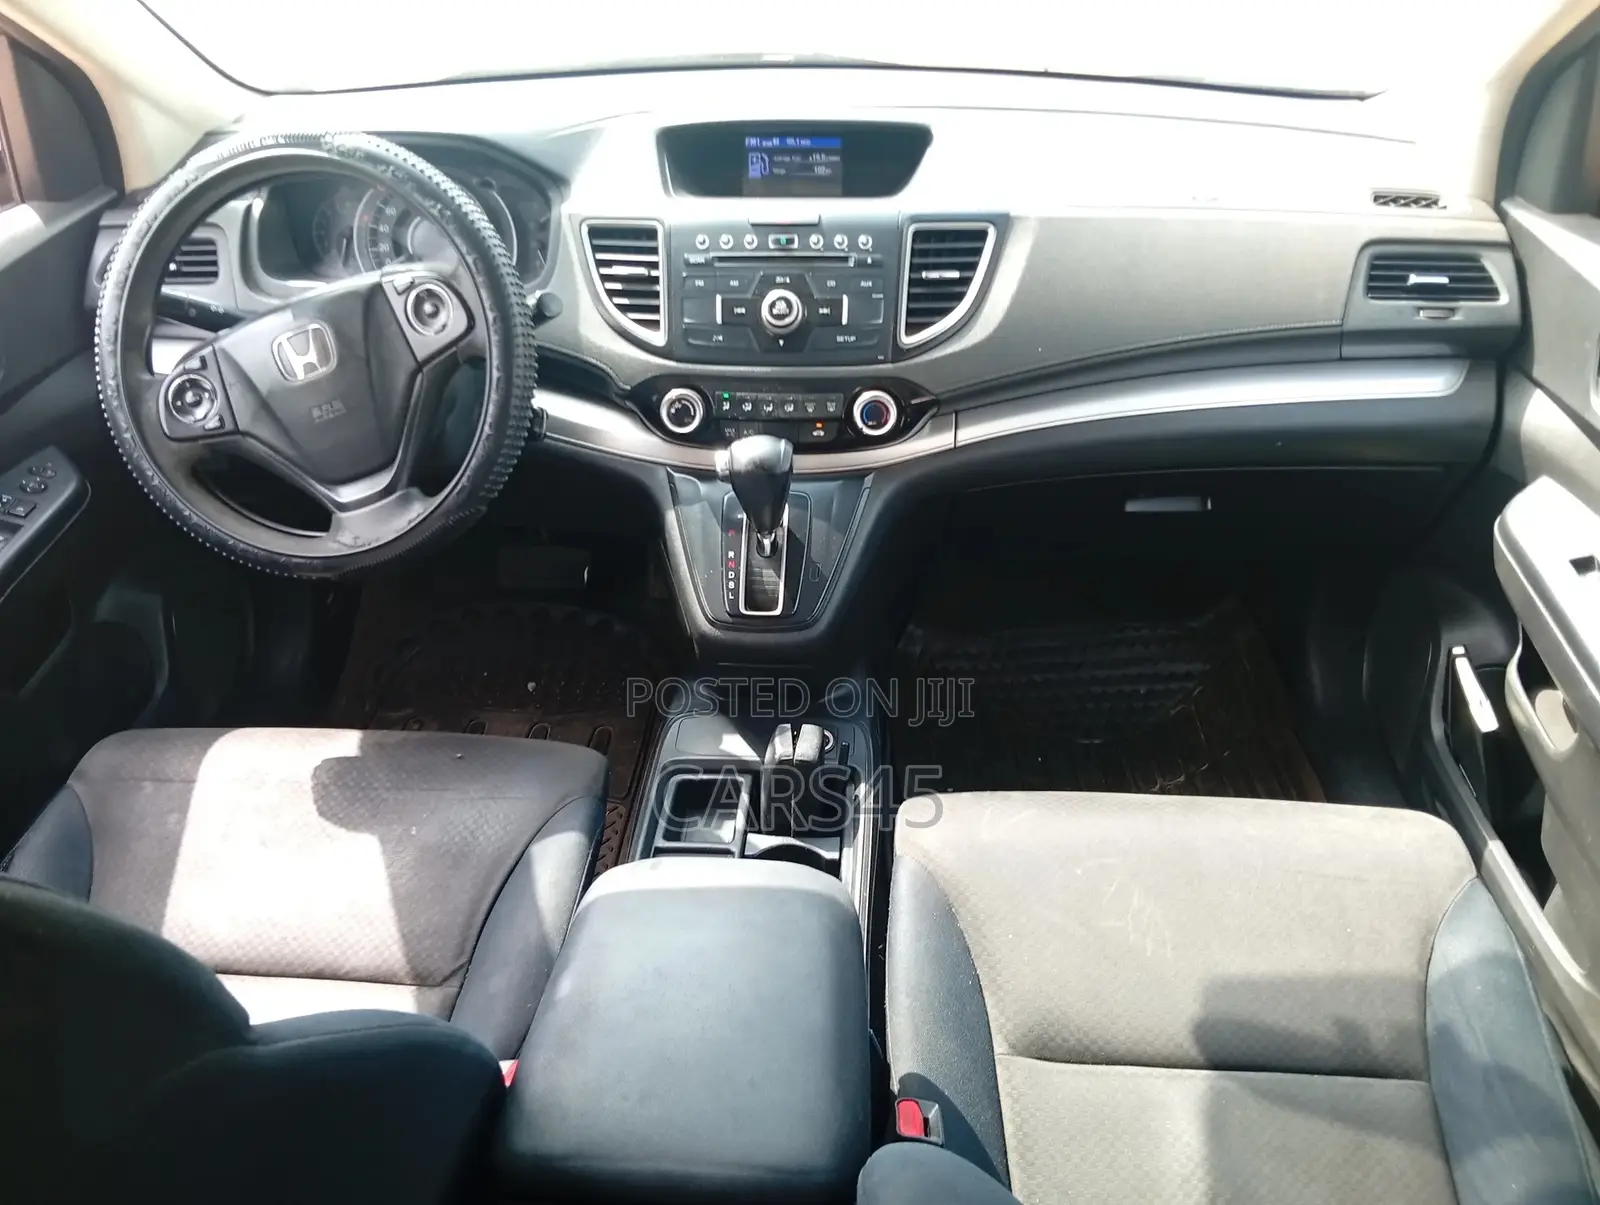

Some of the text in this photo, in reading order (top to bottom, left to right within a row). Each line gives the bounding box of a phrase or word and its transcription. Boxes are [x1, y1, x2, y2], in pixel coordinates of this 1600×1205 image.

[836, 334, 857, 343] SETUP
[728, 551, 735, 559] R
[728, 571, 735, 579] D
[728, 592, 735, 600] L
